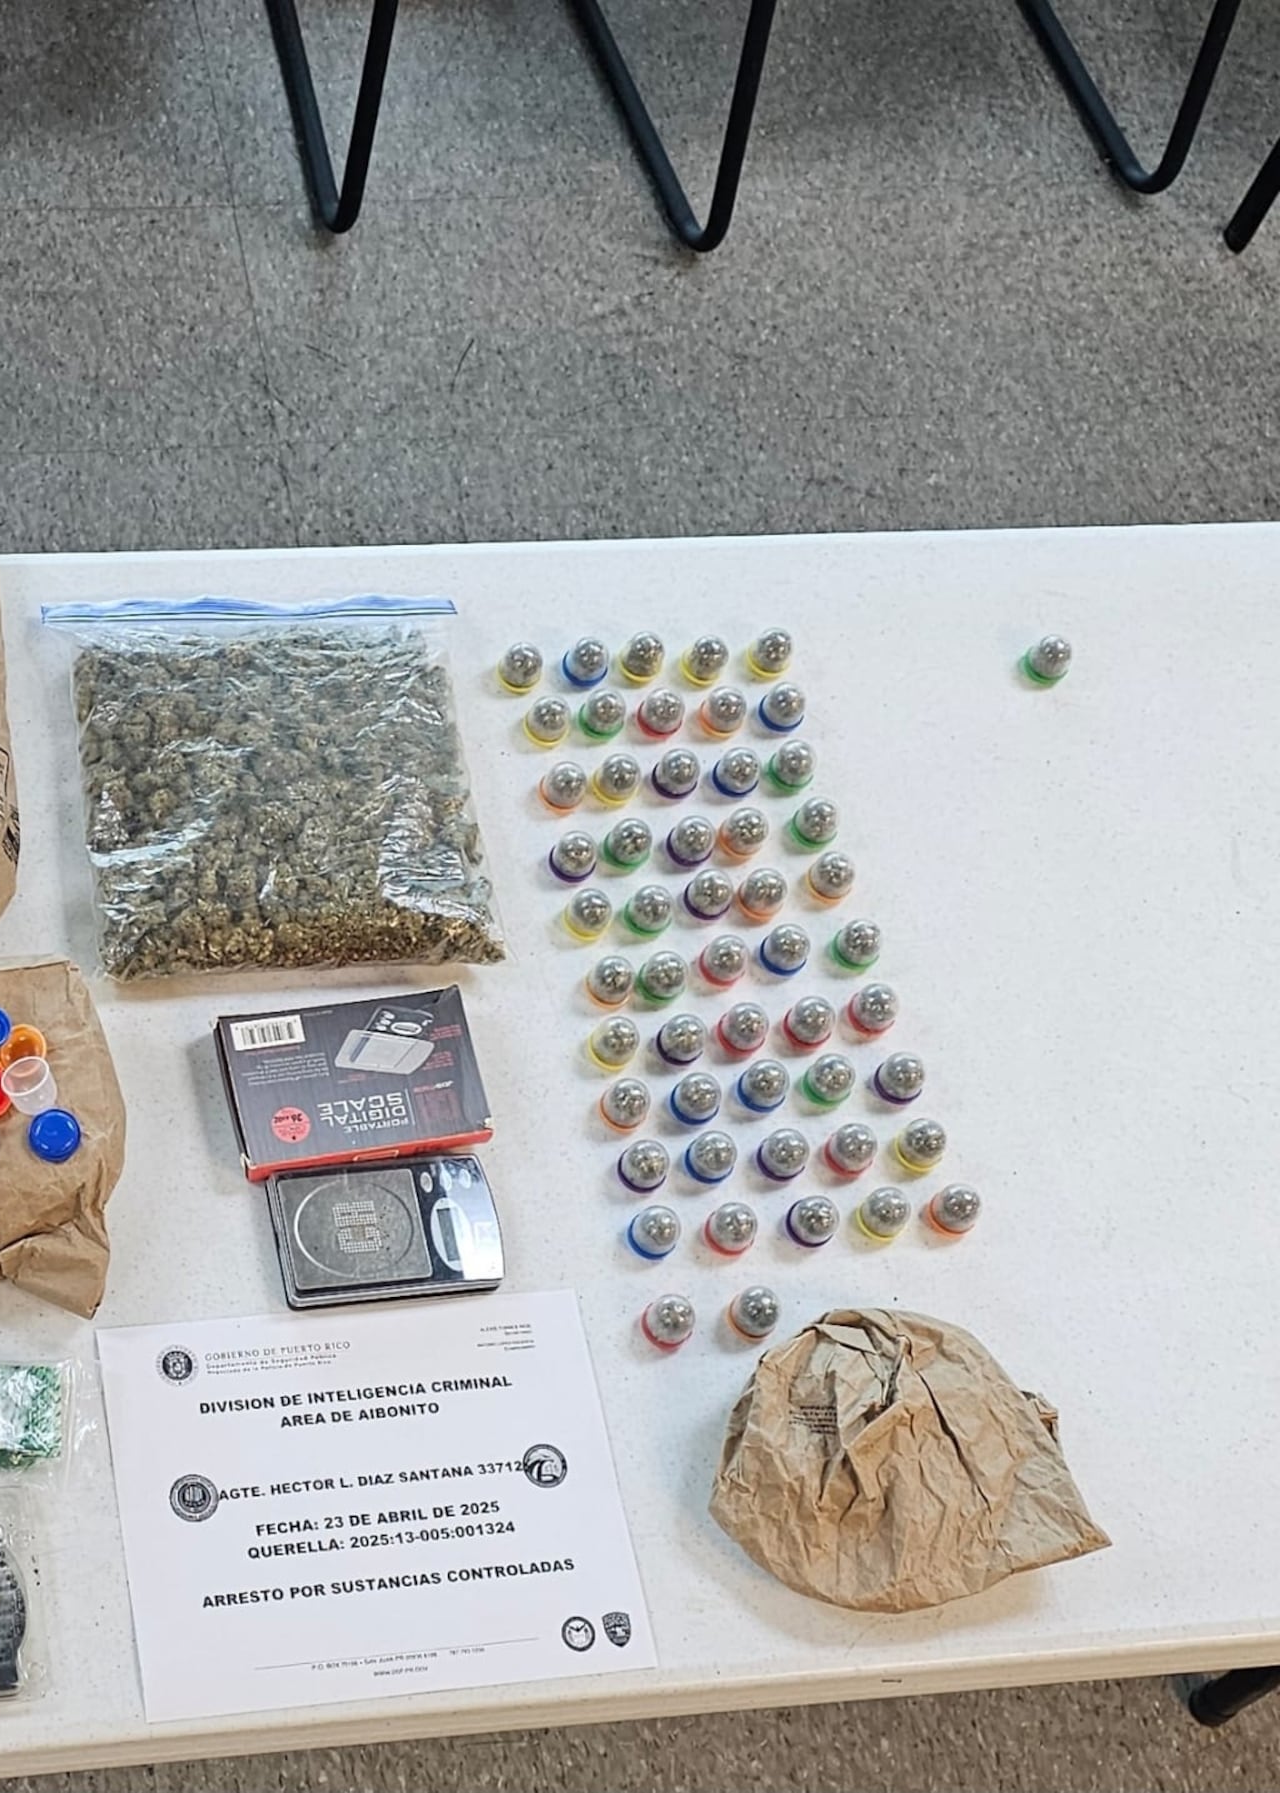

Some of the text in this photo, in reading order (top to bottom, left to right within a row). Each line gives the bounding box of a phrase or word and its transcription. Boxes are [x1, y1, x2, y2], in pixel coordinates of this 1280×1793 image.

[317, 1092, 403, 1115] SCALE
[320, 1105, 406, 1127] DIGITAL
[343, 1117, 410, 1133] PORTABLE
[205, 1340, 351, 1361] GOBIERNO DE PUERTO RICO
[199, 1375, 512, 1414] DIVISION DE INTELIGENCIA CRIMINAL
[280, 1402, 440, 1428] AREA DE AIBONITO
[219, 1486, 266, 1501] AGTE.
[270, 1477, 336, 1496] HECTOR
[339, 1476, 354, 1489] L.
[357, 1473, 395, 1487] DIAZ
[398, 1465, 474, 1483] SANTANA
[255, 1500, 500, 1537] FECHA: 23 DE ABRIL DE 2025
[247, 1521, 515, 1559] QUERELLA: 2025:13-005:001324
[202, 1557, 575, 1608] ARRESTO POR SUSTANCIAS CONTROLADAS
